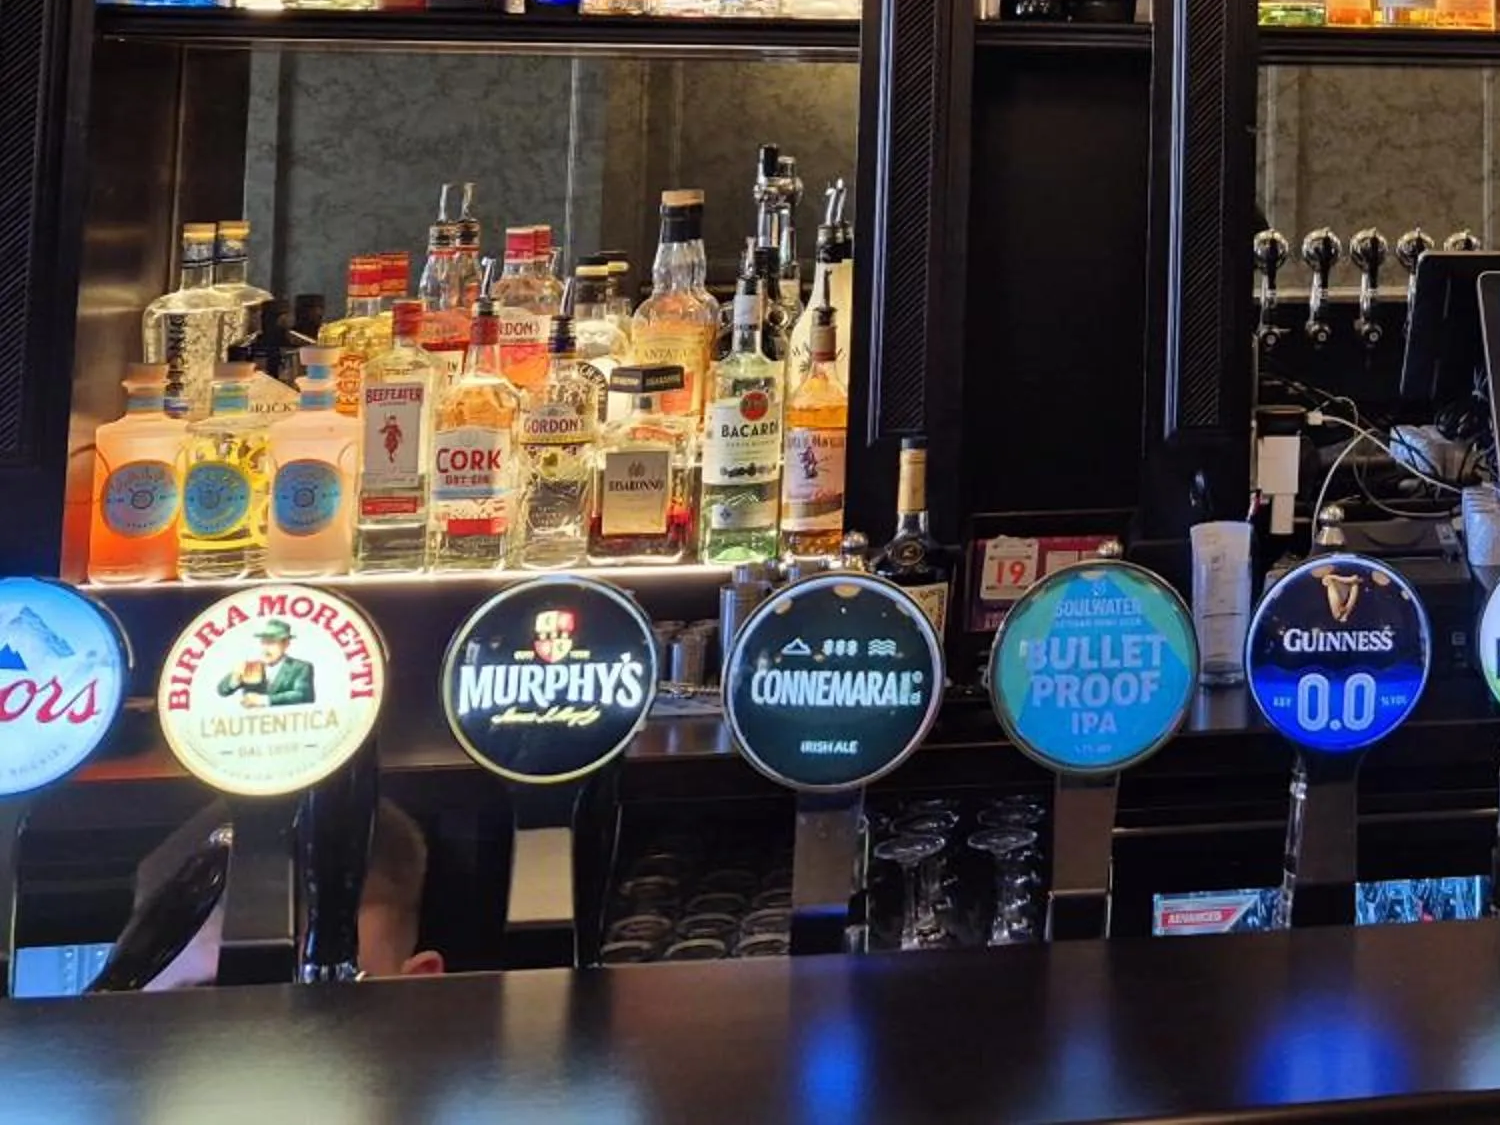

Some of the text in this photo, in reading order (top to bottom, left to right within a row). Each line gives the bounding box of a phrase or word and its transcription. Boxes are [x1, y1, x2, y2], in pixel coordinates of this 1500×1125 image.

[366, 387, 424, 405] BEEFEATER
[436, 448, 503, 474] CORK
[996, 560, 1026, 585] 19
[168, 594, 375, 712] BIRRA MORETTI
[1025, 634, 1166, 671] BULLET
[1283, 627, 1394, 653] GUINNESS
[457, 650, 645, 716] MURPHY'S
[1030, 670, 1162, 708] PROOF
[0, 675, 98, 724] ors
[1297, 672, 1377, 732] 0.0
[199, 709, 339, 739] L'AUTENTICA
[1070, 711, 1118, 736] IPA
[801, 739, 860, 755] IRISH ALE
